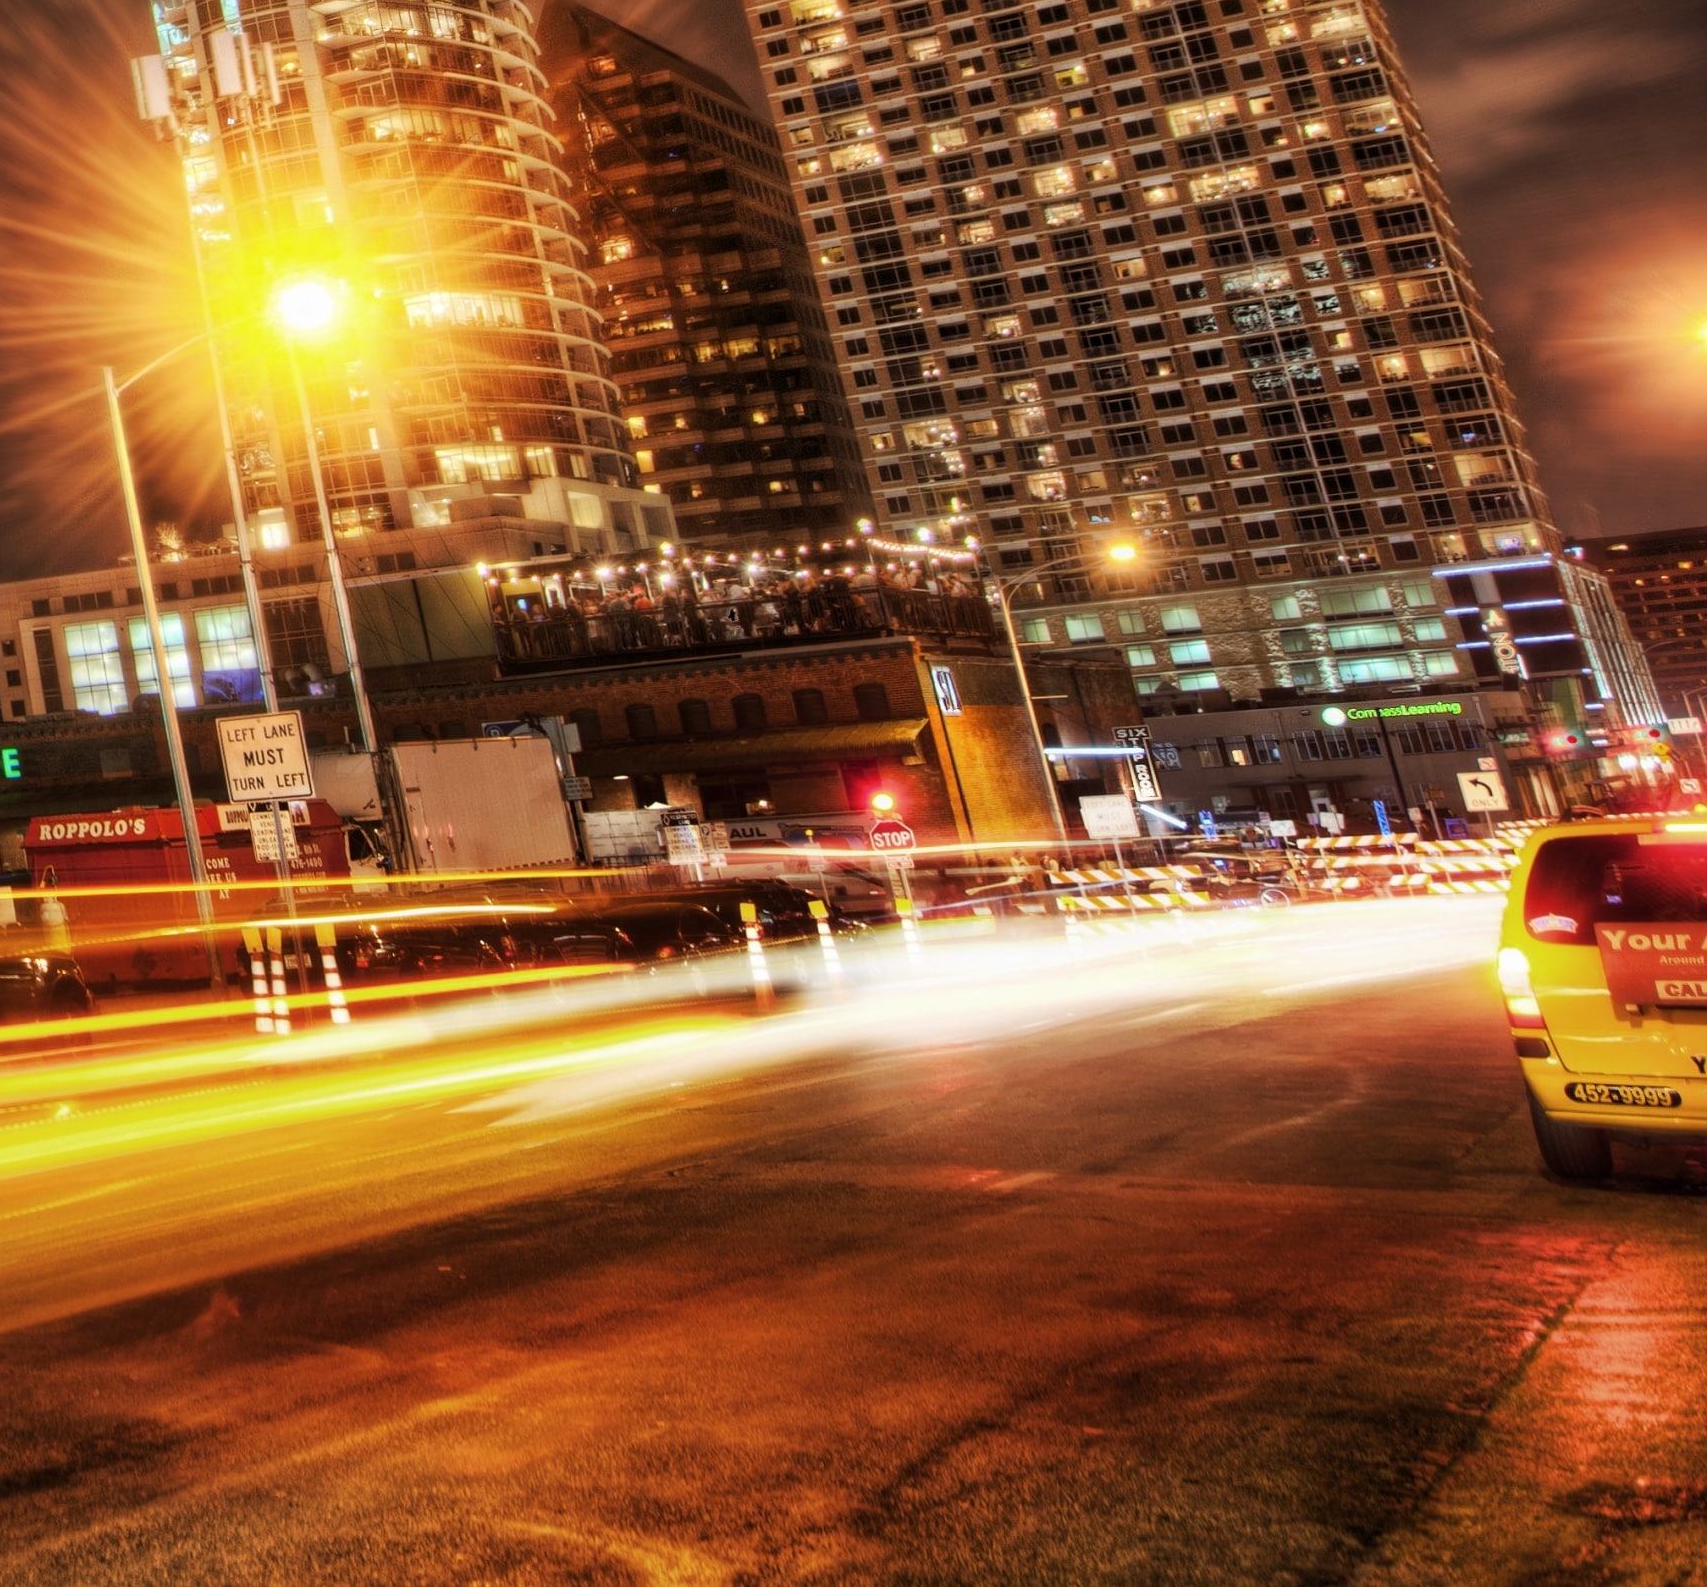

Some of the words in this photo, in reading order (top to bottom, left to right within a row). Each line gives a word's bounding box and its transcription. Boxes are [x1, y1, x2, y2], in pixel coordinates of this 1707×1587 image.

[1347, 702, 1462, 720] ComassLearning
[227, 728, 255, 742] LEFT
[263, 723, 295, 739] LANE
[1116, 728, 1147, 738] SIX
[243, 748, 284, 767] MUST
[1128, 737, 1144, 762] TP
[232, 776, 265, 791] TURN
[276, 773, 305, 788] LEFT
[1471, 798, 1500, 808] ONLY
[39, 818, 146, 842] ROPPOLO'S
[873, 831, 911, 847] STOP
[205, 857, 230, 870] COME
[225, 872, 237, 883] US
[219, 889, 230, 900] AT
[1602, 930, 1691, 951] Your
[1659, 955, 1705, 965] Around
[1665, 983, 1707, 997] CAL
